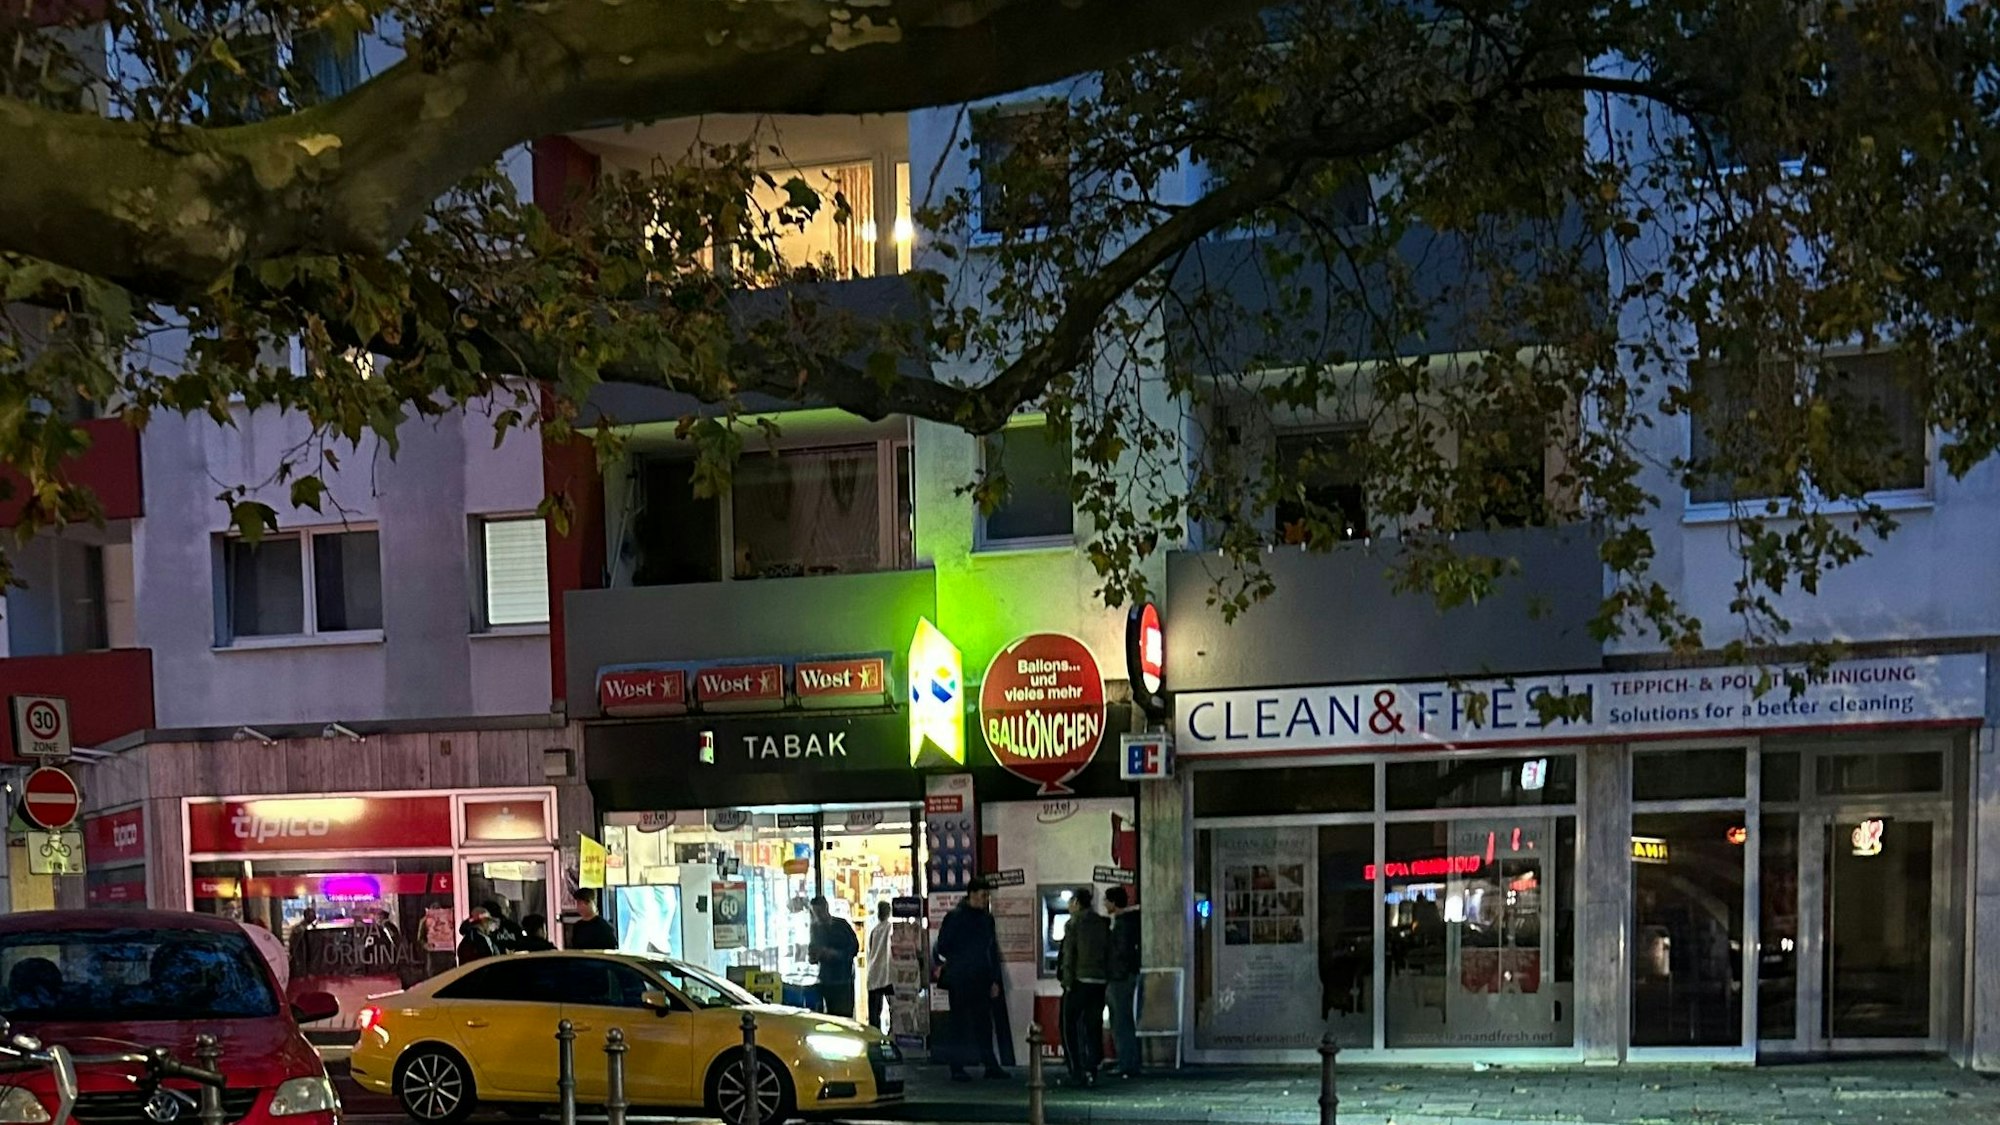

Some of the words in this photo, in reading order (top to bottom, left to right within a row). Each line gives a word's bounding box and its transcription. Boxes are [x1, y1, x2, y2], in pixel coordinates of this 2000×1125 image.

[1017, 658, 1081, 674] Ballons...
[701, 674, 753, 694] West
[799, 668, 853, 689] West
[1030, 672, 1057, 687] und
[1611, 677, 1694, 696] TEPPICH-
[1699, 677, 1713, 692] &
[605, 681, 656, 699] West
[1004, 687, 1044, 702] vieles
[1047, 684, 1083, 700] mehr
[1610, 705, 1699, 724] Solutions
[1706, 701, 1733, 719] for
[1742, 705, 1752, 717] a
[1758, 699, 1820, 716] better
[1829, 694, 1914, 715] cleaning
[33, 711, 53, 729] 30
[988, 708, 1099, 760] BALLÖNCHEN
[32, 741, 59, 753] ZONE
[742, 732, 847, 760] TABAK
[231, 807, 330, 844] tipico
[720, 899, 738, 917] 60
